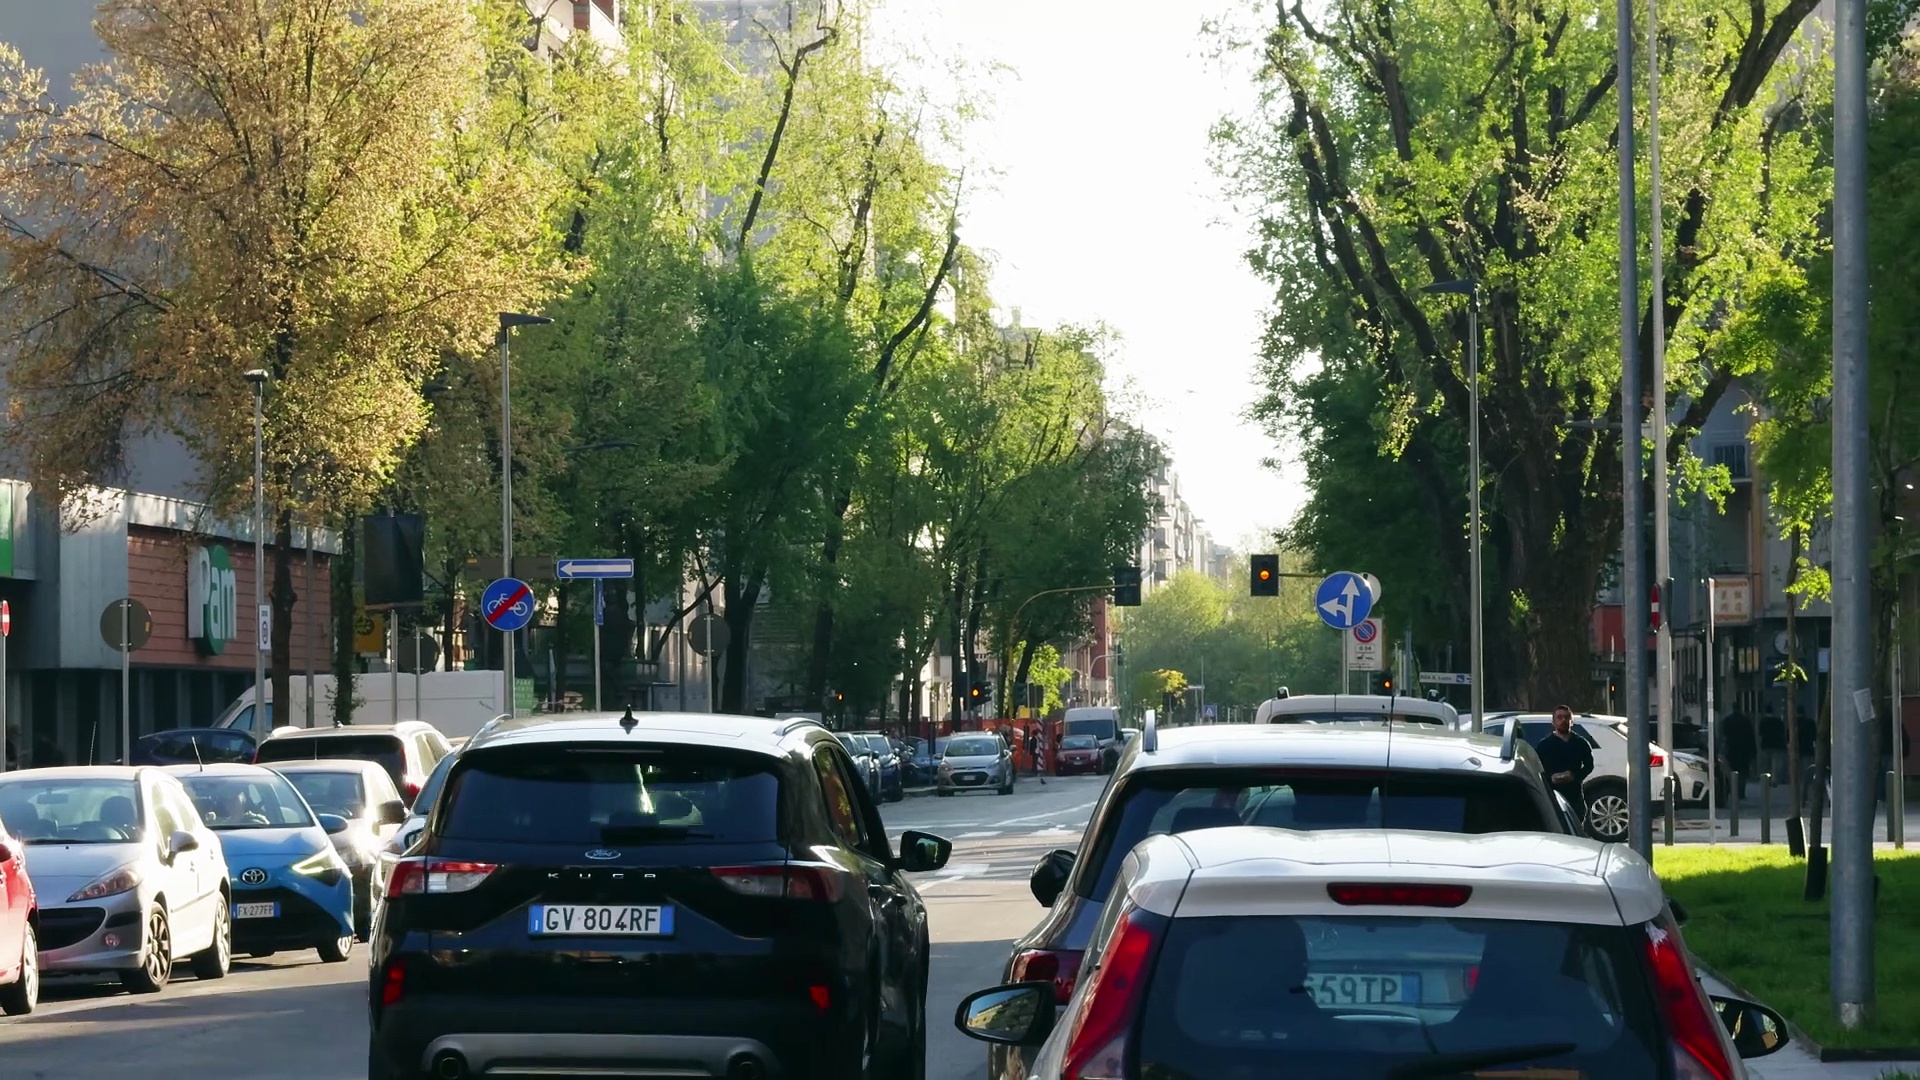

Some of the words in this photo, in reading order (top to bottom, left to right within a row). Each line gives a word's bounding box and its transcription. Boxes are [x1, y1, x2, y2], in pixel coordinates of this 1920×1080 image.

[187, 546, 237, 640] Pam
[548, 872, 656, 880] KUGA
[546, 907, 575, 931] GV
[583, 907, 658, 931] 804RF
